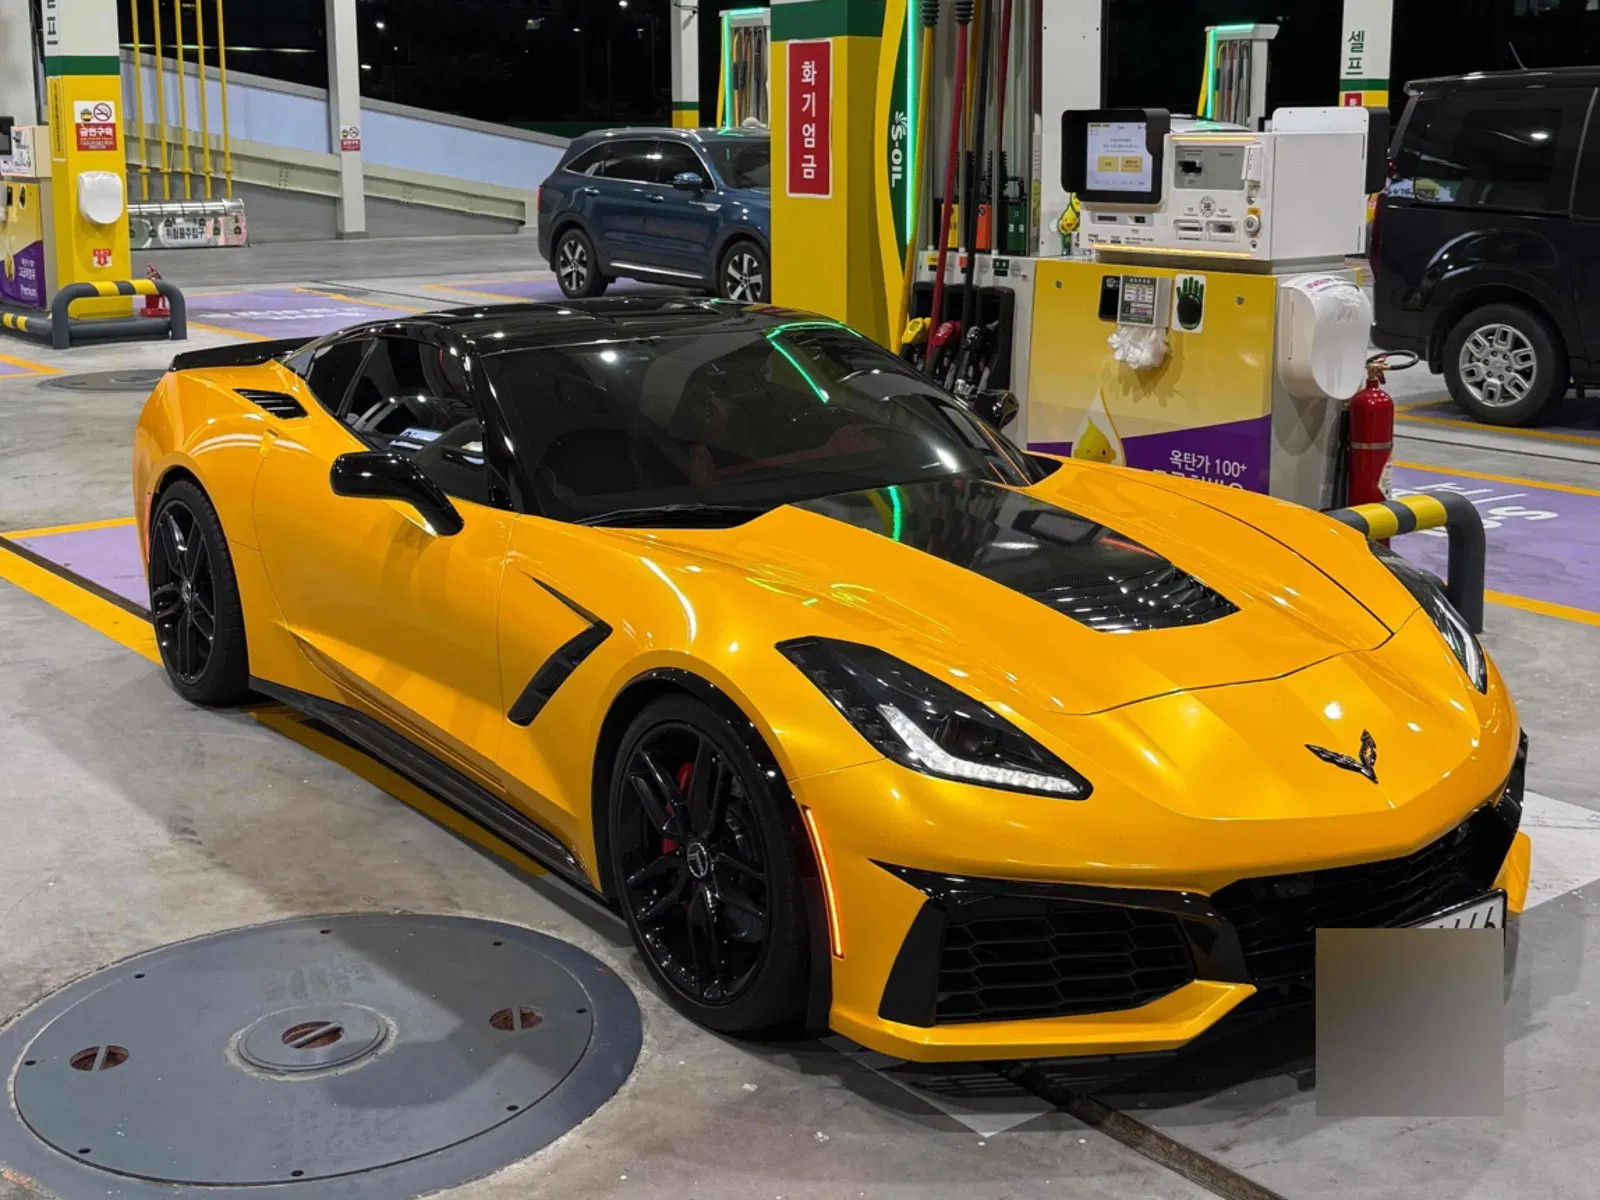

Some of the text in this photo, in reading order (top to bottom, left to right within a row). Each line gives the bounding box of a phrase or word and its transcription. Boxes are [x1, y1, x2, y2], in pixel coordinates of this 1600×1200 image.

[1345, 30, 1366, 75] 셀프
[801, 60, 817, 179] 화기엄금
[891, 124, 903, 188] S-OIL
[166, 226, 204, 240] 위험물주입구
[1169, 449, 1247, 478] 옥탄가 100+
